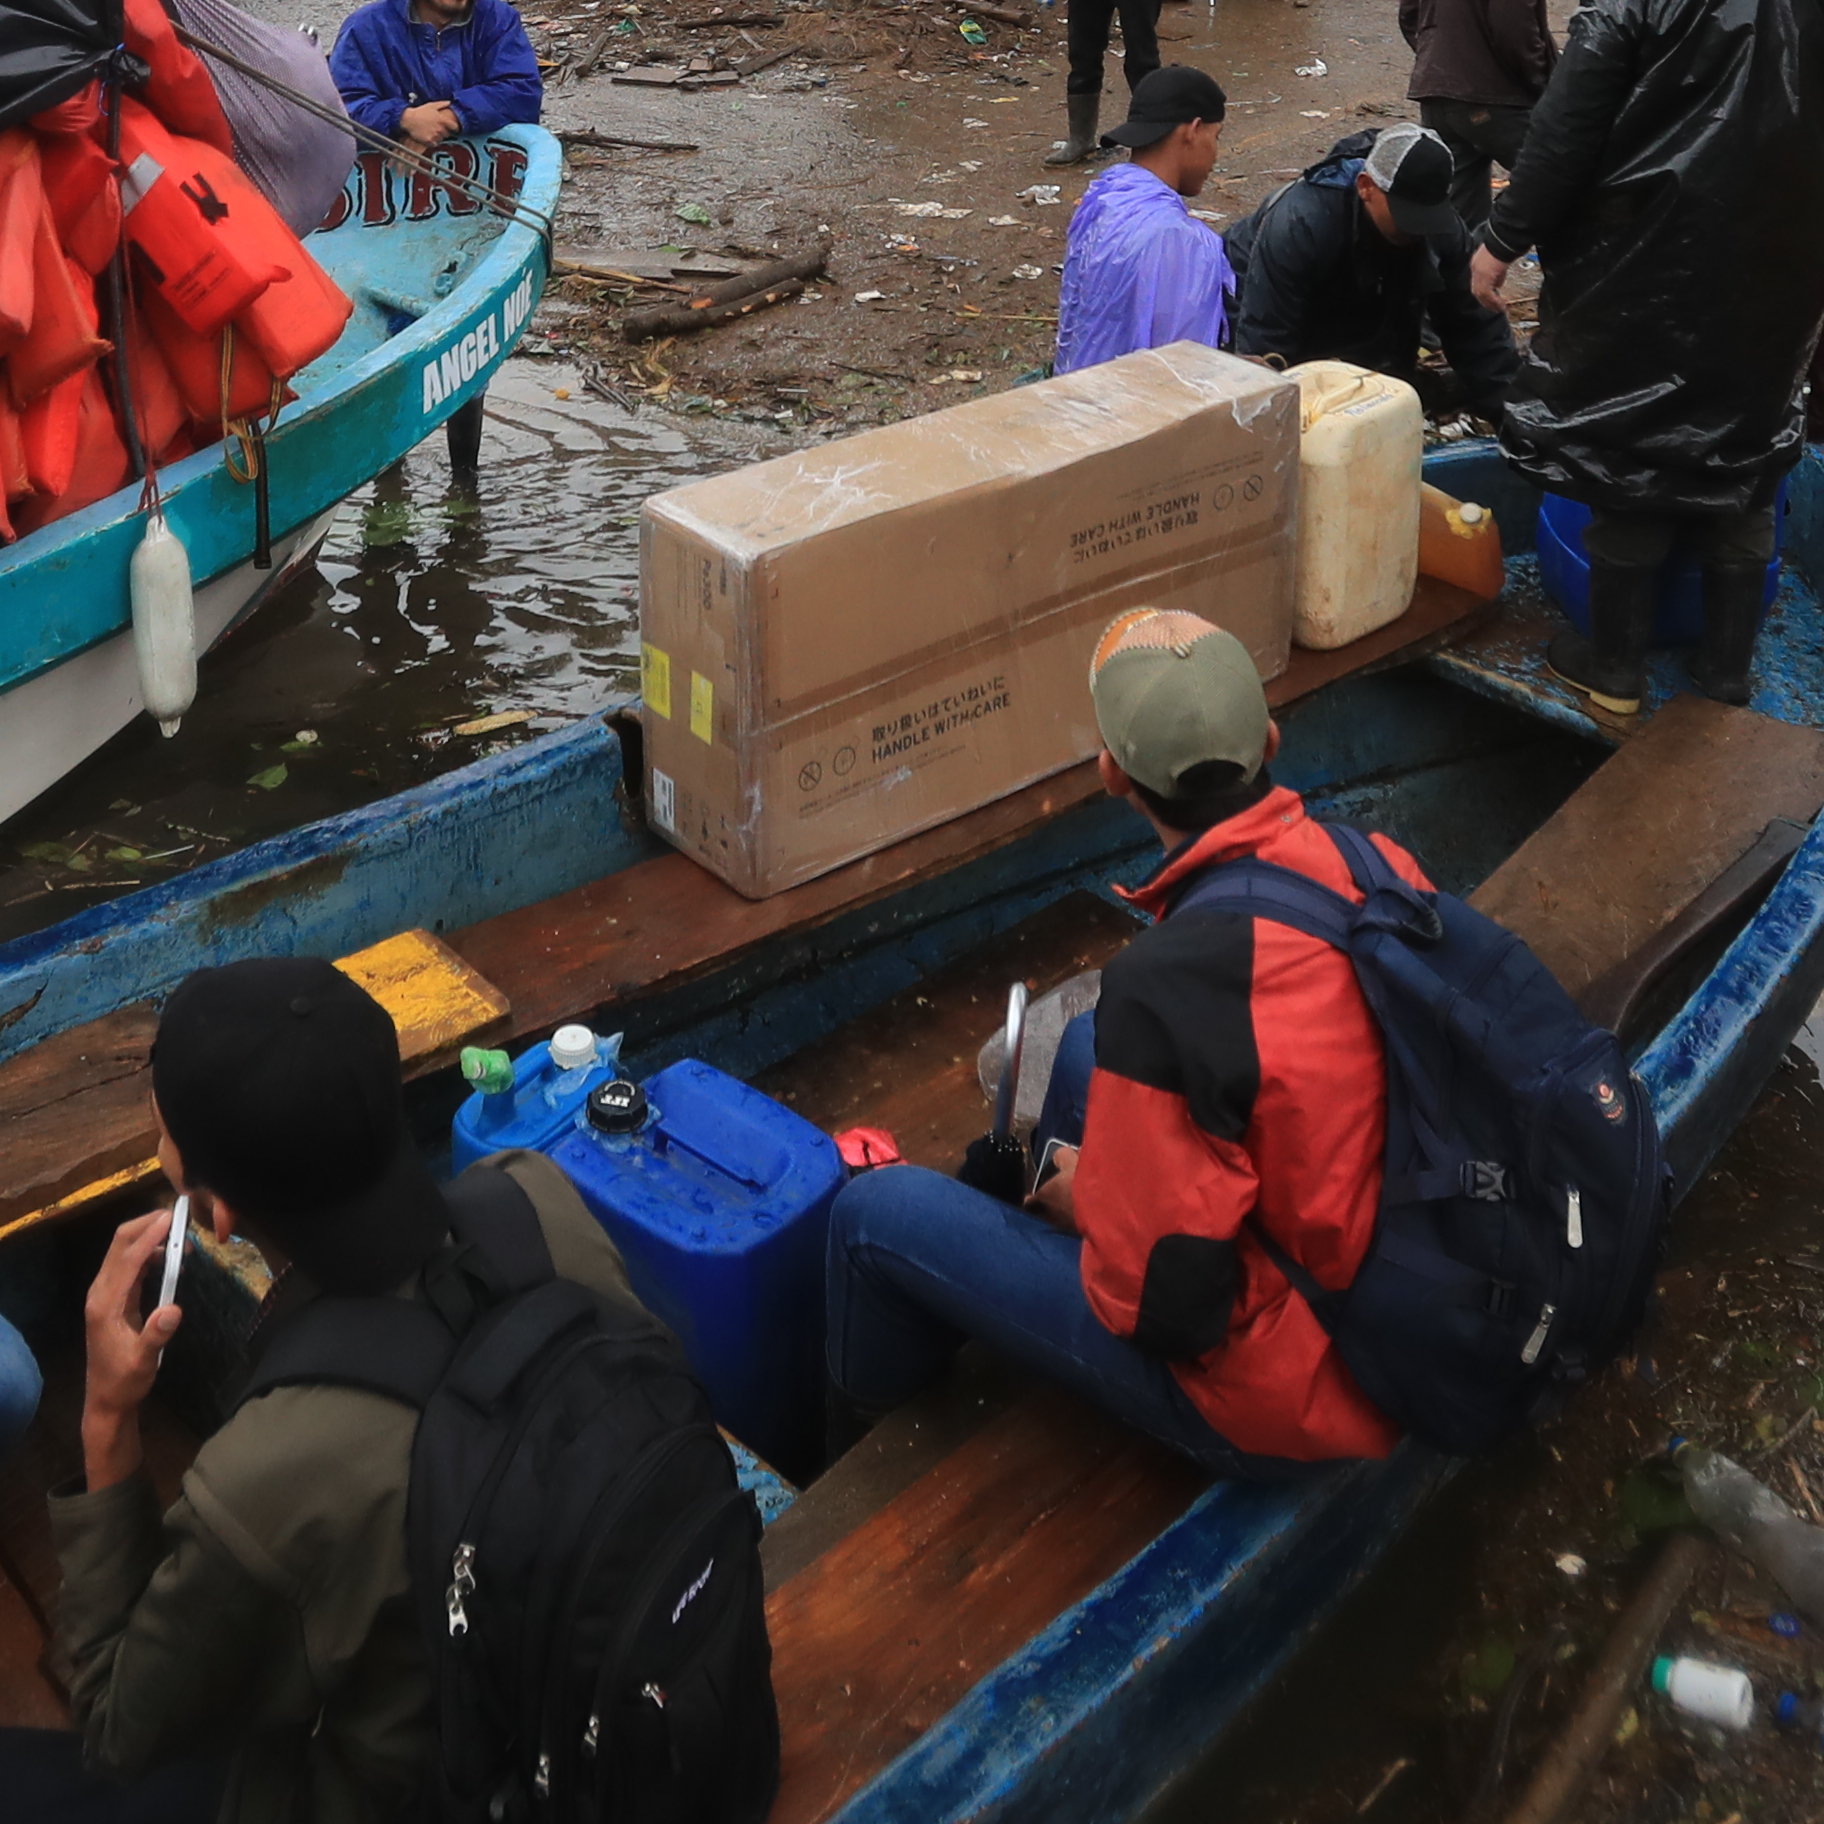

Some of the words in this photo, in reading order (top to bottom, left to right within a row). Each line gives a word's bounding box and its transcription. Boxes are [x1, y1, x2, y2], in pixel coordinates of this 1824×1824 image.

[422, 313, 500, 415] ANGEL
[1108, 510, 1142, 535] WITH
[1147, 491, 1200, 521] HANDLE
[1070, 525, 1105, 549] CARE
[871, 674, 1006, 744] 取り扱いはていねいに
[872, 727, 930, 764] HANDLE
[933, 709, 972, 736] WITH
[973, 691, 1012, 720] CARE
